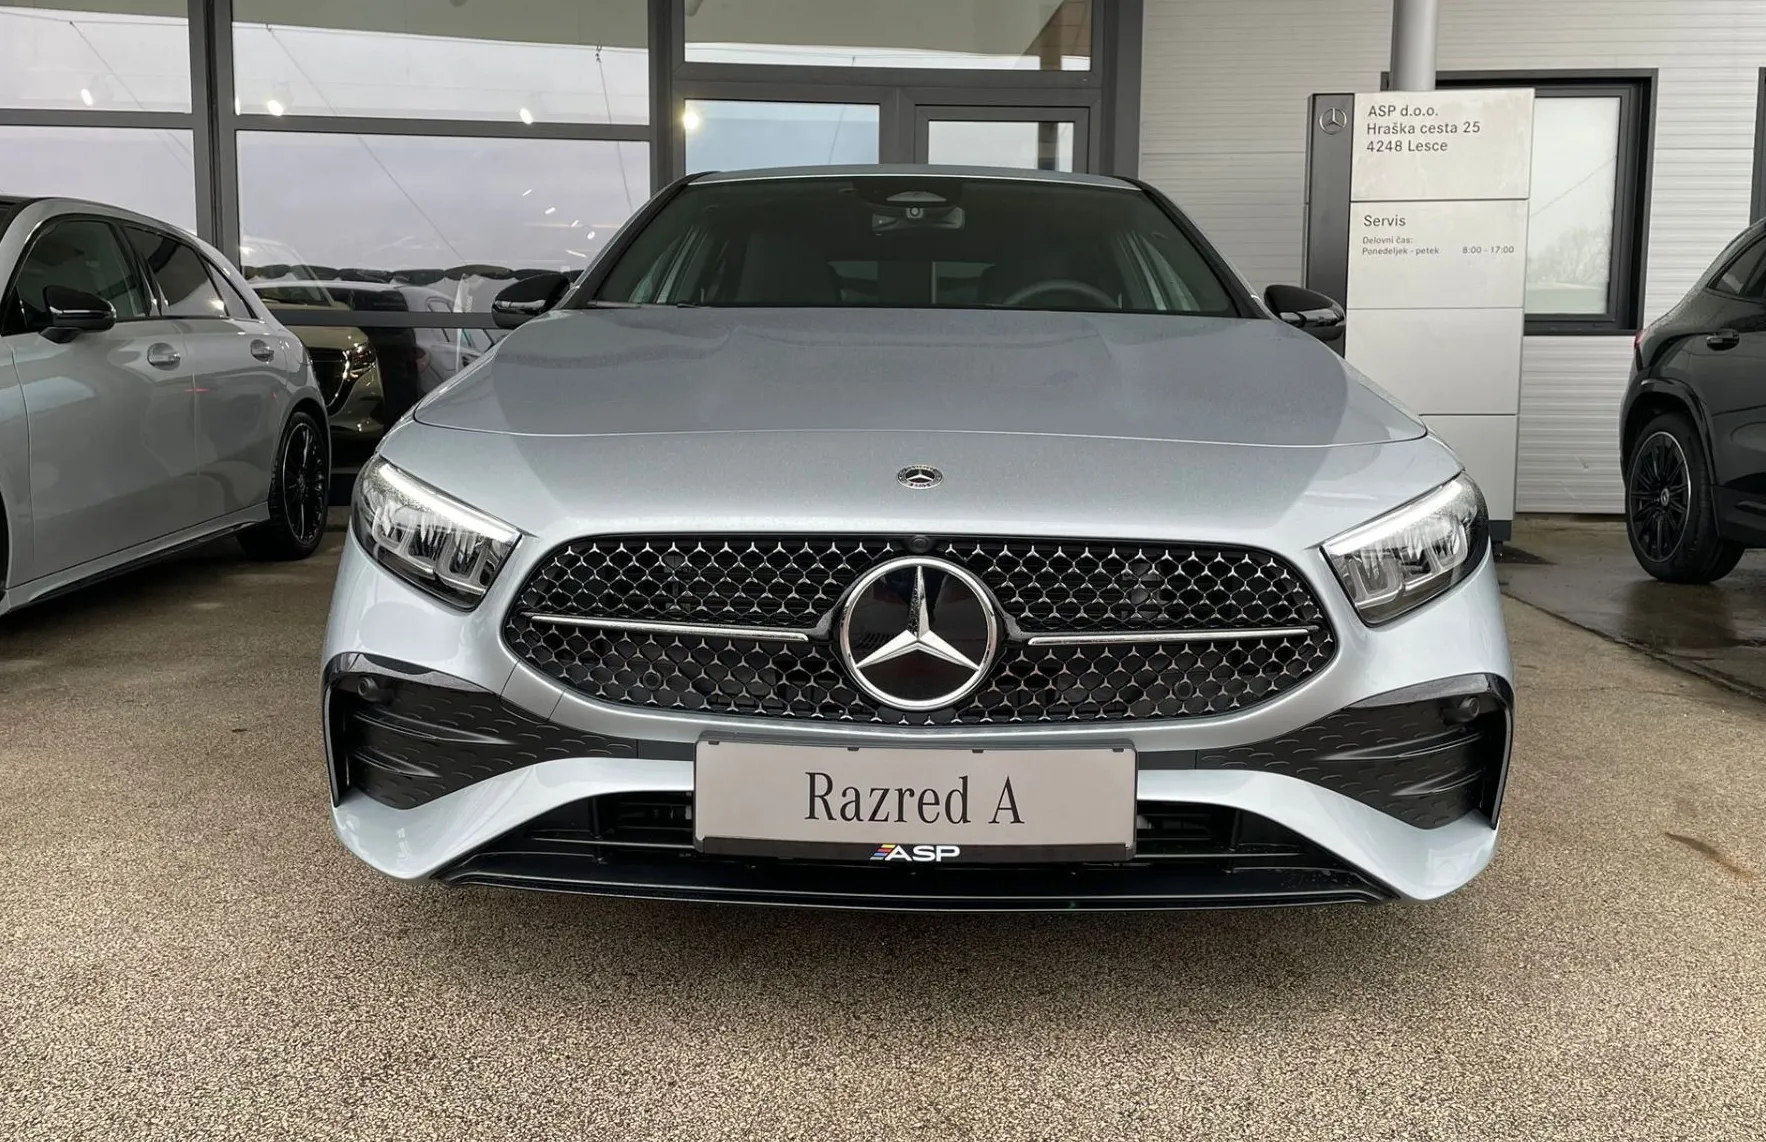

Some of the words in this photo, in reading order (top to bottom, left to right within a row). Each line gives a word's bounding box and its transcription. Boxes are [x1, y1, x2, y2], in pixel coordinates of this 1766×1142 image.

[1367, 104, 1397, 118] ASP
[1399, 104, 1440, 117] d.o.o.
[1366, 121, 1416, 136] Hraška
[1419, 122, 1459, 135] cesta
[1462, 120, 1481, 134] 25
[1366, 139, 1403, 153] 4248
[1407, 139, 1449, 153] Lesce
[1362, 214, 1407, 228] Servis
[1362, 236, 1395, 245] Delovni
[1395, 236, 1414, 245] čas:
[1361, 246, 1409, 257] Ponedeljek
[1415, 246, 1441, 256] petek
[1461, 245, 1483, 255] 8:00
[1490, 245, 1516, 255] 17:00
[804, 771, 972, 826] Razred
[988, 775, 1026, 825] A
[883, 844, 961, 862] ASP
